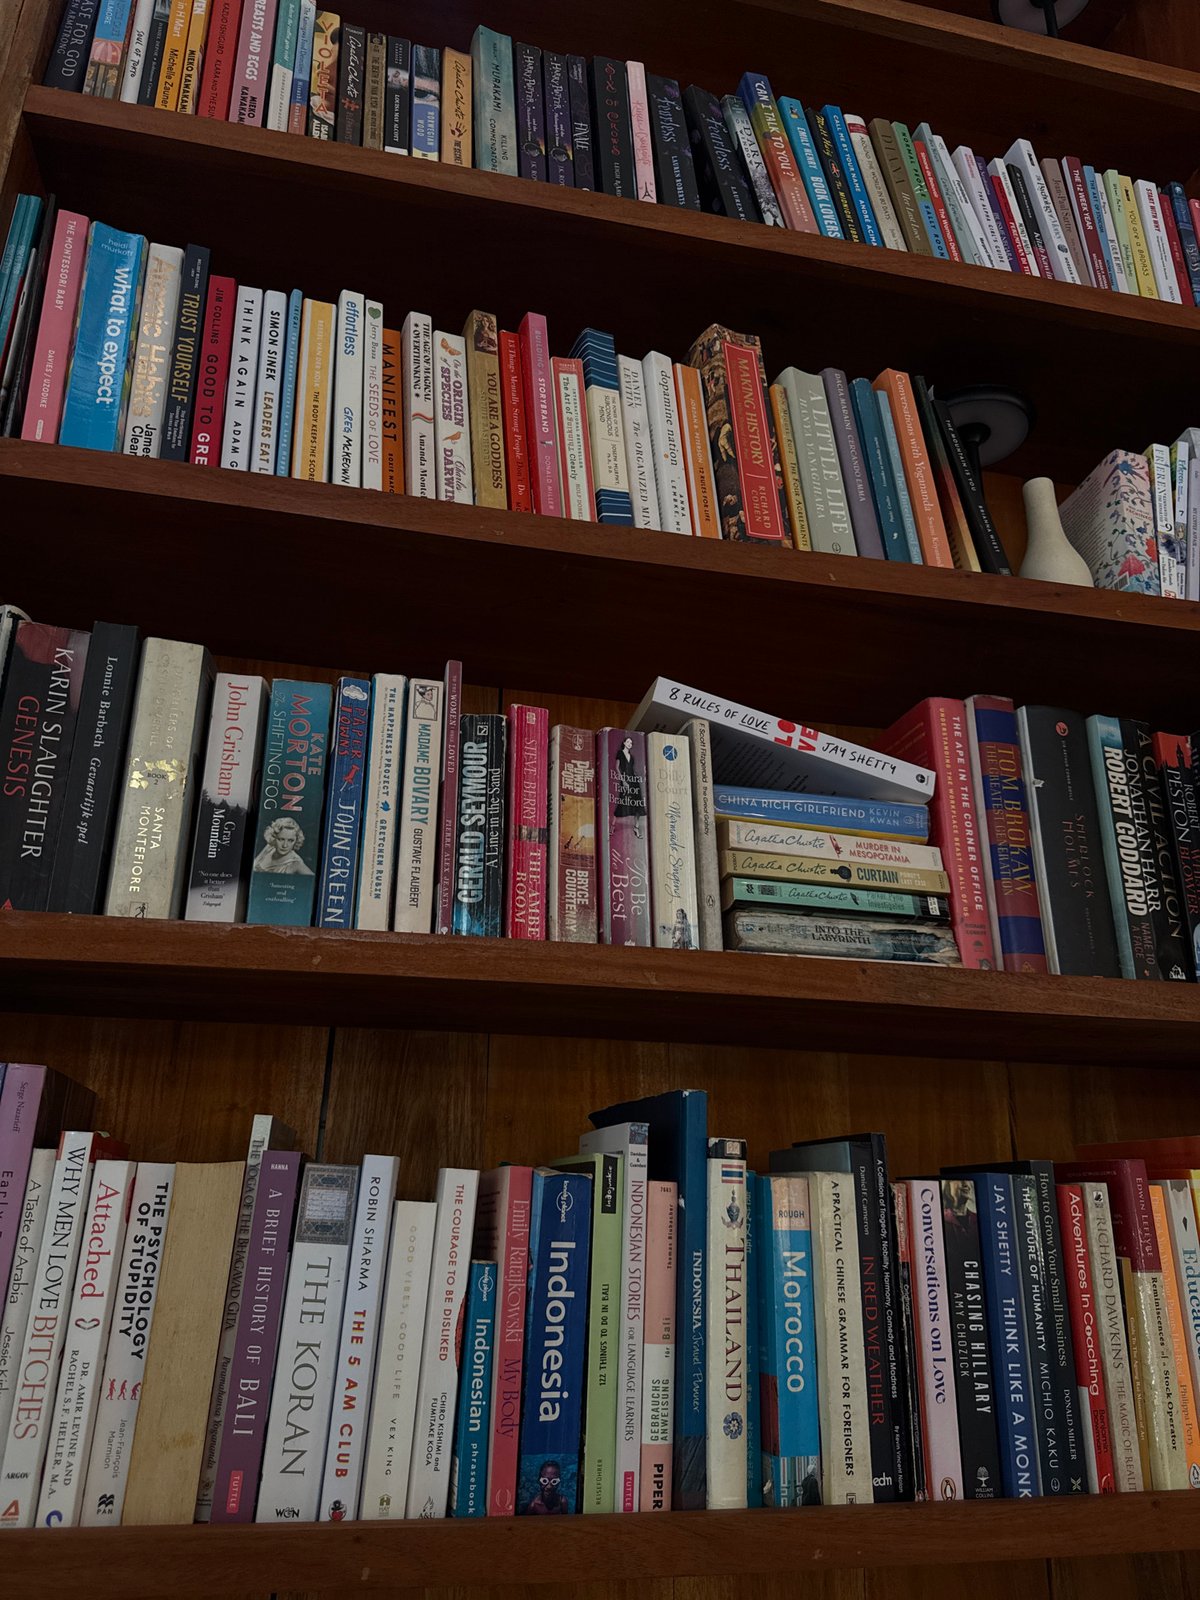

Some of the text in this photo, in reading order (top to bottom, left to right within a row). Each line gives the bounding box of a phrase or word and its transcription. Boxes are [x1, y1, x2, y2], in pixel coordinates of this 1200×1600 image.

[62, 22, 88, 76] FOR GOD
[173, 20, 184, 37] Mart
[186, 50, 196, 71] MIEKO
[245, 38, 261, 80] AND EGGS
[161, 48, 178, 108] Michelle Zauner
[315, 20, 333, 114] VIOLETA
[492, 63, 501, 112] MURAKAMI
[247, 96, 257, 118] MIEKO
[764, 113, 779, 133] TALK
[770, 136, 782, 155] TO
[798, 128, 817, 169] EMILY HENRY
[108, 239, 128, 249] heidi
[811, 177, 840, 238] BOOK LOVERS
[56, 221, 76, 310] THE MONTESSORI BABY
[96, 268, 132, 404] what to expect
[181, 292, 200, 334] TRUST
[266, 311, 280, 381] SIMON SINEK
[345, 301, 359, 356] effortless
[172, 337, 195, 403] YOURSELF
[200, 355, 218, 424] GOOD TO
[235, 299, 254, 407] THINK AGAIN
[413, 330, 421, 391] OVERTHINKING
[259, 392, 274, 462] LEADERS EAT
[369, 383, 379, 464] SEEDS LOVE
[382, 344, 397, 442] MANIFEST
[440, 366, 453, 421] SPECIES
[453, 380, 464, 427] ORIGIN
[537, 377, 549, 433] STORYBRAND
[661, 370, 678, 466] dopamine nation
[231, 421, 241, 454] ADAM
[490, 432, 503, 489] GODDESS
[746, 413, 764, 468] HISTORY
[809, 390, 849, 534] A LITTLE LIFE
[895, 374, 934, 512] Conversations with Yogananda
[93, 656, 118, 748] Lonnie Barbach
[218, 682, 249, 796] John Grisham
[352, 707, 368, 759] PAPER
[669, 688, 771, 731] 8 RULES OF LOVE
[3, 695, 40, 797] GENESIS
[20, 648, 74, 858] KARIN SLAUGHTER
[264, 711, 287, 810] SHIFTING FOG
[280, 694, 313, 812] MORTON
[308, 733, 324, 775] KATE
[382, 707, 395, 797] HAPPINESS PROJECT
[411, 723, 431, 825] MADAME BOVARY
[610, 770, 643, 783] Barbara
[822, 742, 897, 774] JAY SHETTY
[77, 757, 101, 844] Gevaarlijk spel
[609, 795, 646, 807] Bradford
[613, 783, 640, 797] Taylor
[718, 794, 866, 819] CHINA RICH GIRLFRIEND
[129, 806, 151, 892] MONTEFIORE
[150, 807, 165, 849] SANTA
[208, 808, 226, 858] Mountain
[324, 799, 356, 923] JOHN GREEN
[964, 814, 983, 912] CORNER OFFICE
[1103, 746, 1148, 917] ROBERT GODDARD
[409, 828, 423, 908] GUSTAVE FLAUBERT
[576, 871, 589, 905] BRYCE
[857, 868, 899, 884] CURTAIN
[40, 1146, 86, 1310] WHY MEN LOVE
[80, 1180, 120, 1300] Attached
[358, 1176, 380, 1291] ROBIN SHARMA
[627, 1180, 644, 1321] INDONESIAN STORIES
[779, 1210, 804, 1218] ROUGH
[994, 1185, 1012, 1276] JAY SHETTY
[1069, 1191, 1088, 1289] Adventures
[119, 1234, 146, 1338] STUPIDITY
[131, 1226, 162, 1360] PSYCHOLOGY
[233, 1209, 280, 1435] BRIEF HISTORY OF BALI
[439, 1208, 461, 1361] COURAGE DISLIKED
[692, 1251, 702, 1332] INDONESIA
[726, 1238, 744, 1402] THAILAND
[783, 1251, 806, 1393] Morocco
[920, 1188, 947, 1405] Conversations on Love
[280, 1257, 332, 1476] THE KORAN
[539, 1241, 576, 1422] Indonesia
[956, 1323, 970, 1377] CHOZICK
[963, 1260, 991, 1414] CHASING HILLARY
[13, 1315, 58, 1440] BITCHES
[625, 1343, 637, 1442] LANGUAGE LEARNERS
[650, 1379, 661, 1442] GEBRAUCHS
[660, 1379, 670, 1442] ANWEISUNG
[1002, 1298, 1031, 1498] THINK LIKE MONK
[335, 1356, 361, 1478] 5 AM CLUB
[436, 1423, 444, 1458] KISHIMI
[468, 1319, 491, 1514] Indonesian phrasebook
[1167, 1402, 1177, 1450] Operator
[385, 1446, 393, 1476] KING
[653, 1463, 664, 1509] PIPER
